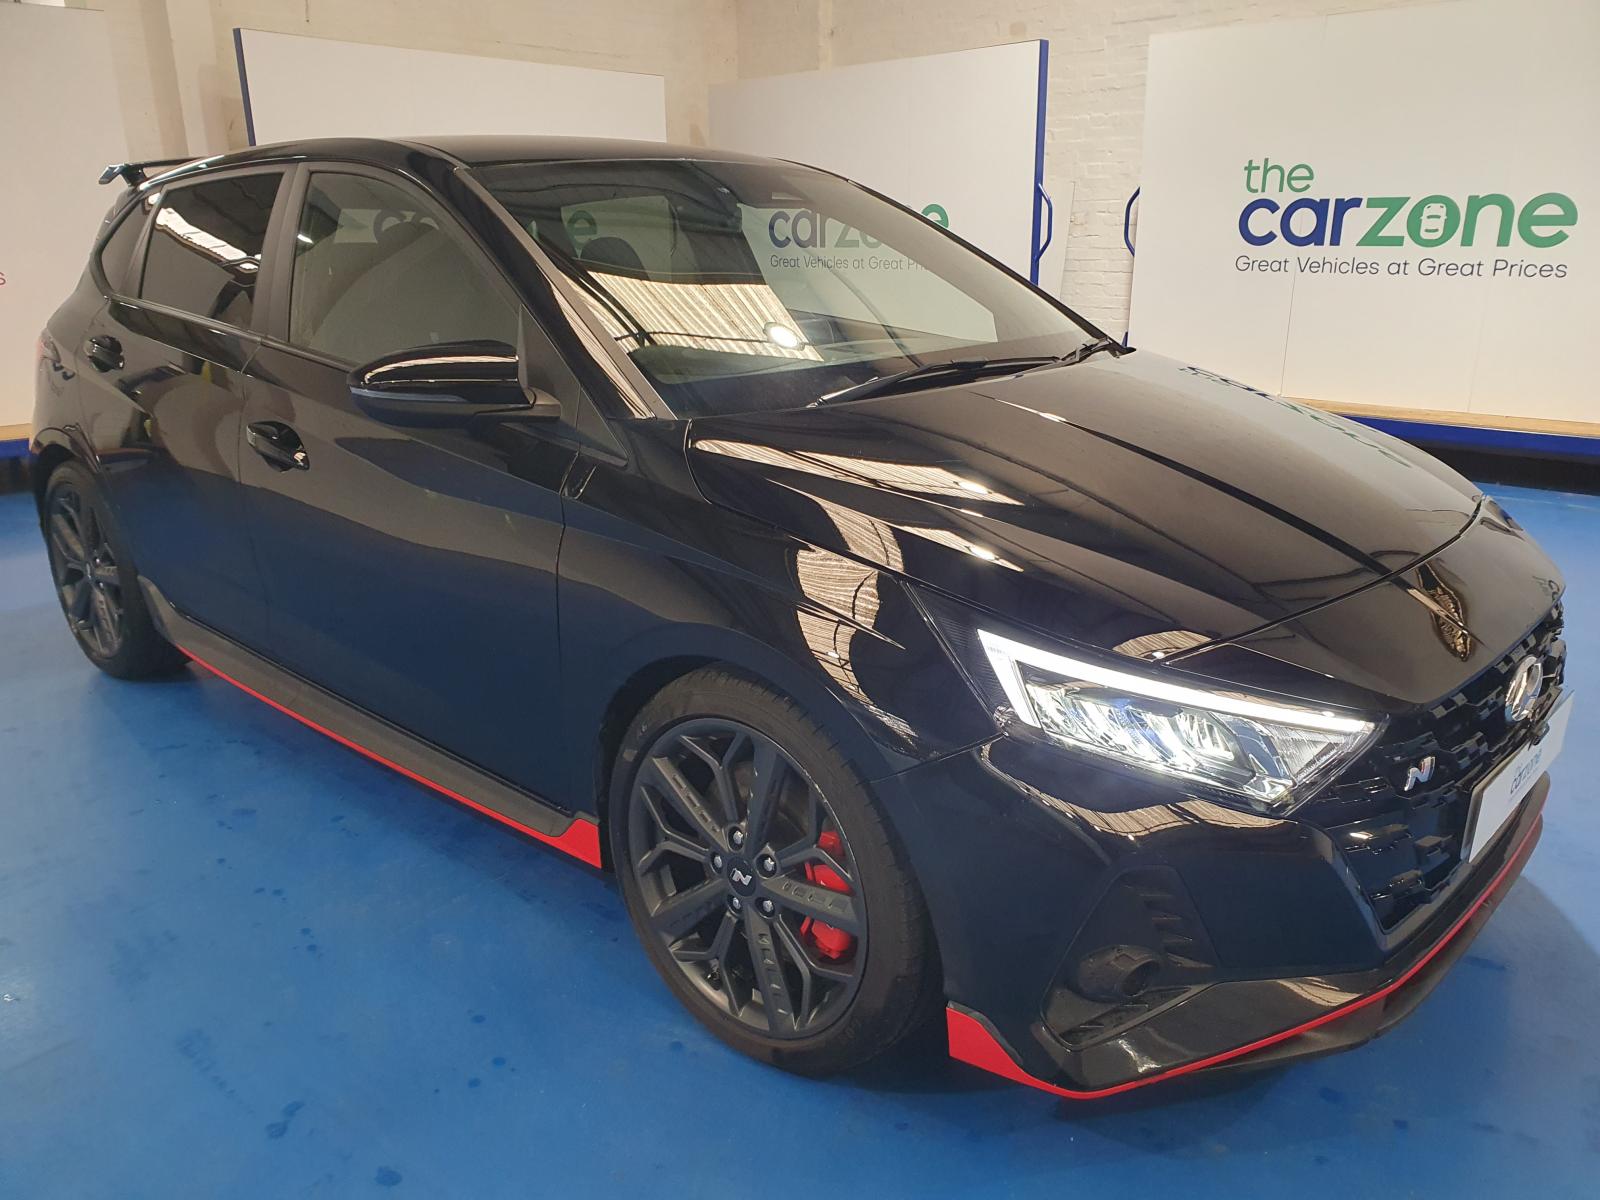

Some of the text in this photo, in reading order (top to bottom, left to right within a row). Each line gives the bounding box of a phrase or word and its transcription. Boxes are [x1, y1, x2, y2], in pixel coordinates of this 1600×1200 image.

[1243, 157, 1315, 193] the
[1238, 191, 1579, 249] carzone
[770, 254, 801, 268] Great
[804, 255, 850, 270] Vehicles
[852, 256, 865, 270] at
[868, 255, 904, 271] Great
[1235, 254, 1569, 279] Great Vehicles at Great Prices
